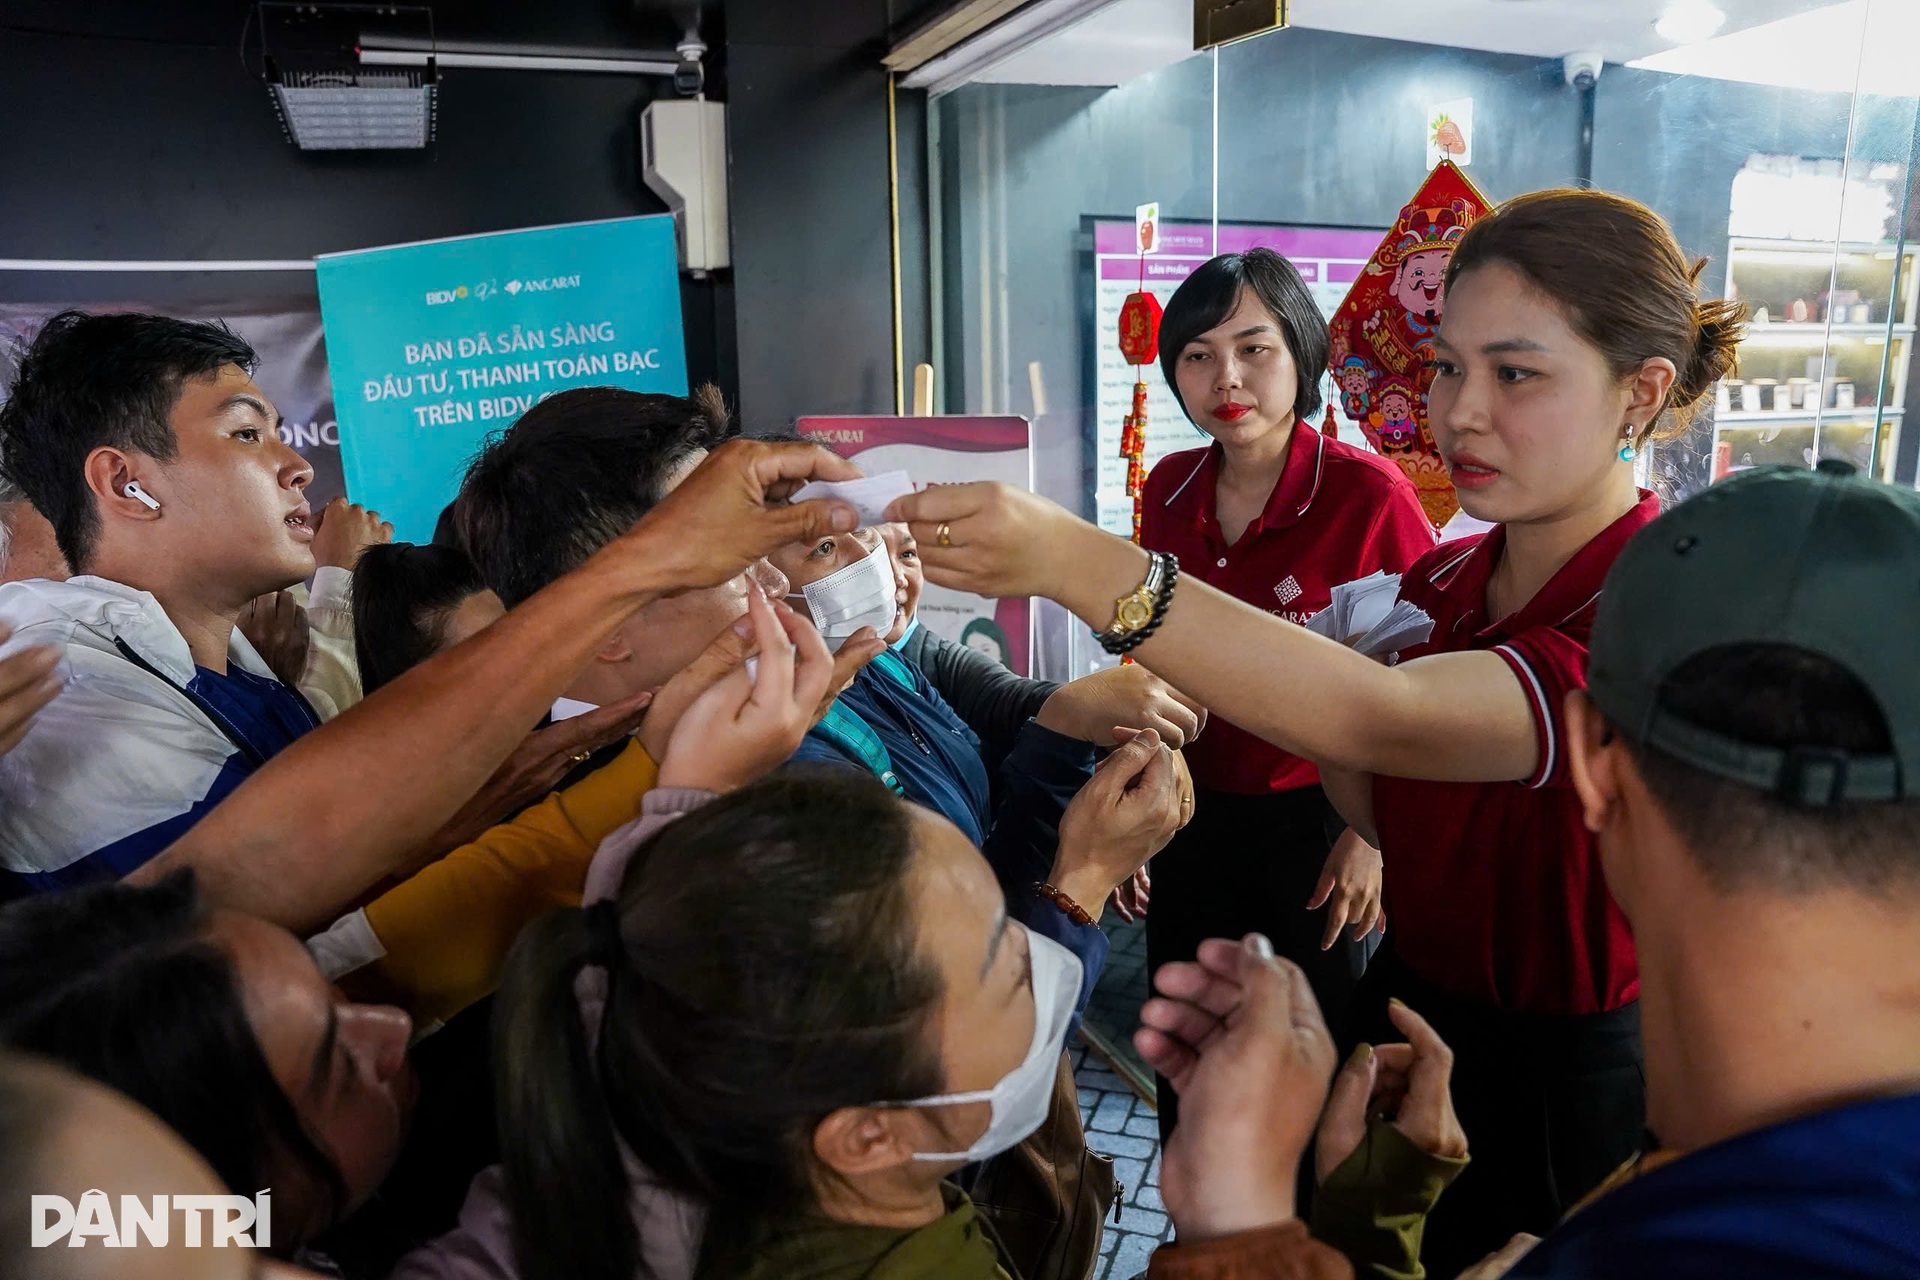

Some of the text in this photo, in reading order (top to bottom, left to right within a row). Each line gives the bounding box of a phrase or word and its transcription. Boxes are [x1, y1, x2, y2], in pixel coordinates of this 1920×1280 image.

[425, 289, 457, 306] BIDV
[524, 274, 581, 293] ANCARAT
[404, 339, 454, 367] BẠN
[457, 331, 494, 359] ĐÃ
[550, 320, 615, 348] SÀNG
[415, 369, 455, 395] TƯ,
[456, 361, 541, 391] THANH
[543, 352, 609, 380] TOÁN
[612, 347, 661, 376] BẠC
[413, 399, 474, 428] TRÊN
[477, 393, 532, 421] BIDV
